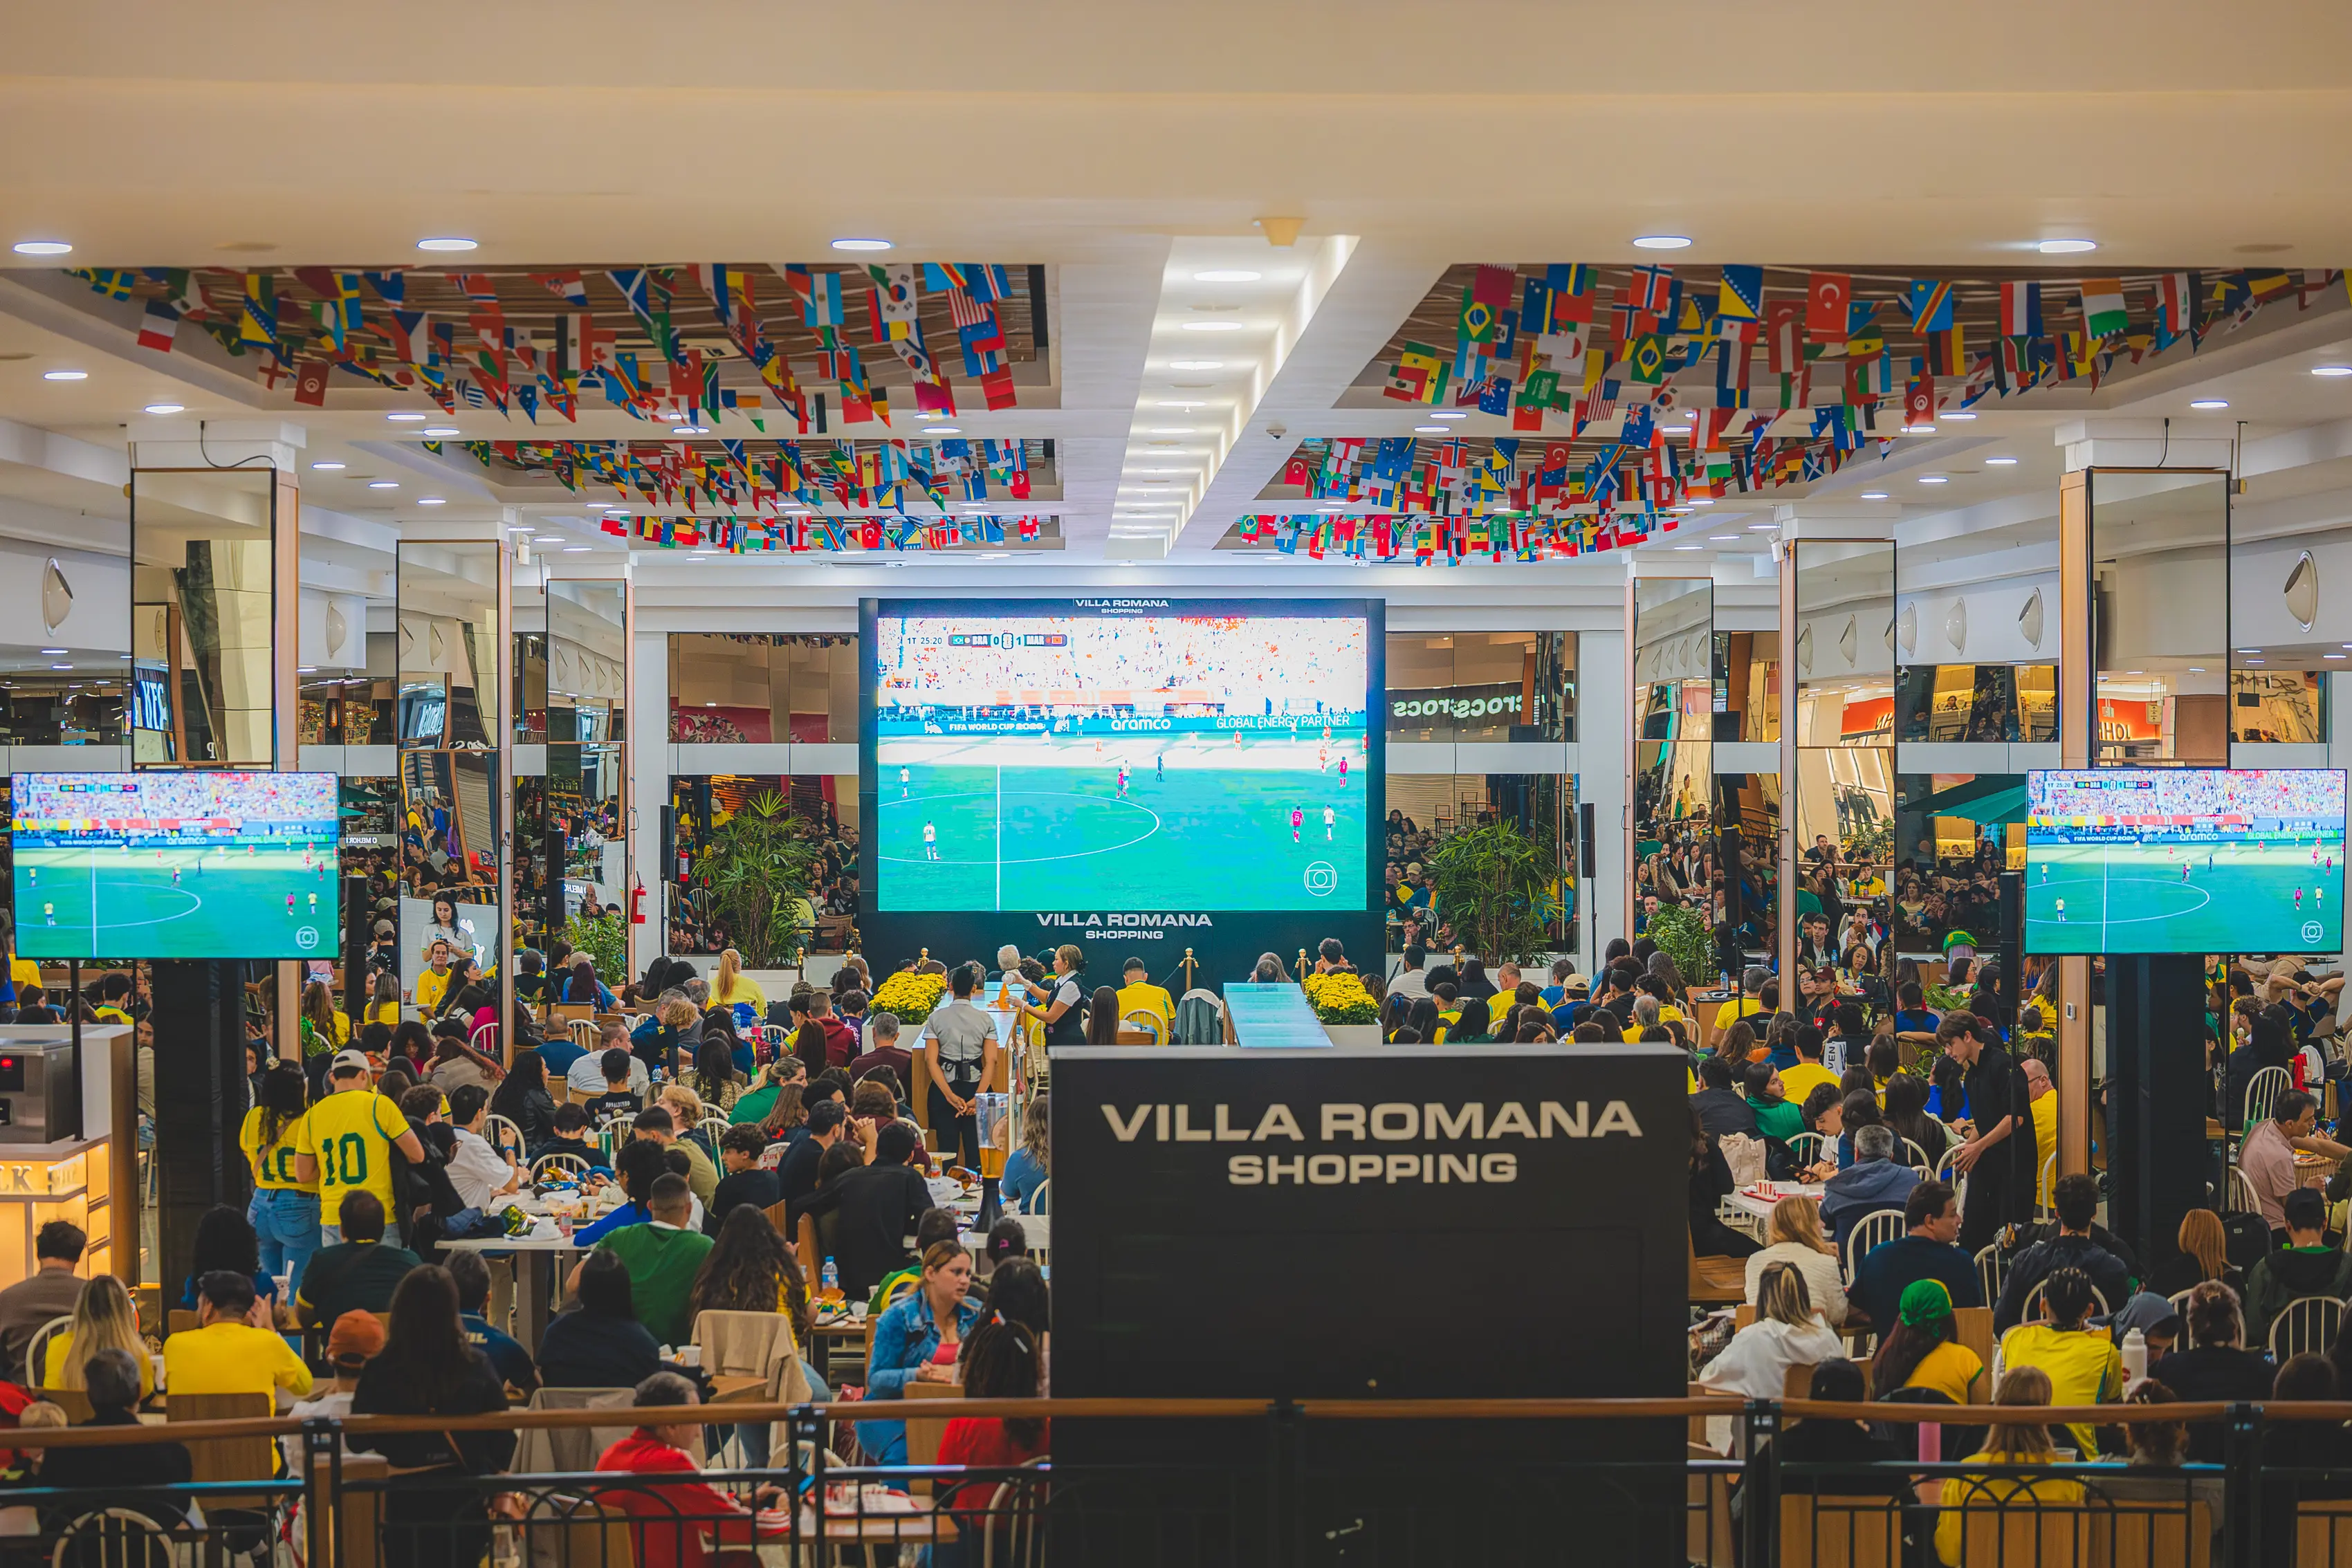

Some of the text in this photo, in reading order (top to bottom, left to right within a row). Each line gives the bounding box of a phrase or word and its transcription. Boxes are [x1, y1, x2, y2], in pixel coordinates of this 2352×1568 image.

[921, 636, 942, 645] 25:20
[972, 635, 988, 646] BRA
[1110, 717, 1171, 731] aramco
[1216, 714, 1350, 729] GLOBAL ENERGY PARTNER
[166, 836, 207, 845] aramco
[2179, 832, 2218, 841] aramco
[2248, 830, 2334, 840] GLOBAL ENERGY PARTNER
[1036, 913, 1213, 927] VILLA ROMANA
[1085, 930, 1164, 939] SHOPPING
[1101, 1100, 1644, 1143] VILLA ROMANA
[322, 1132, 368, 1187] 10
[1227, 1152, 1518, 1186] SHOPPING
